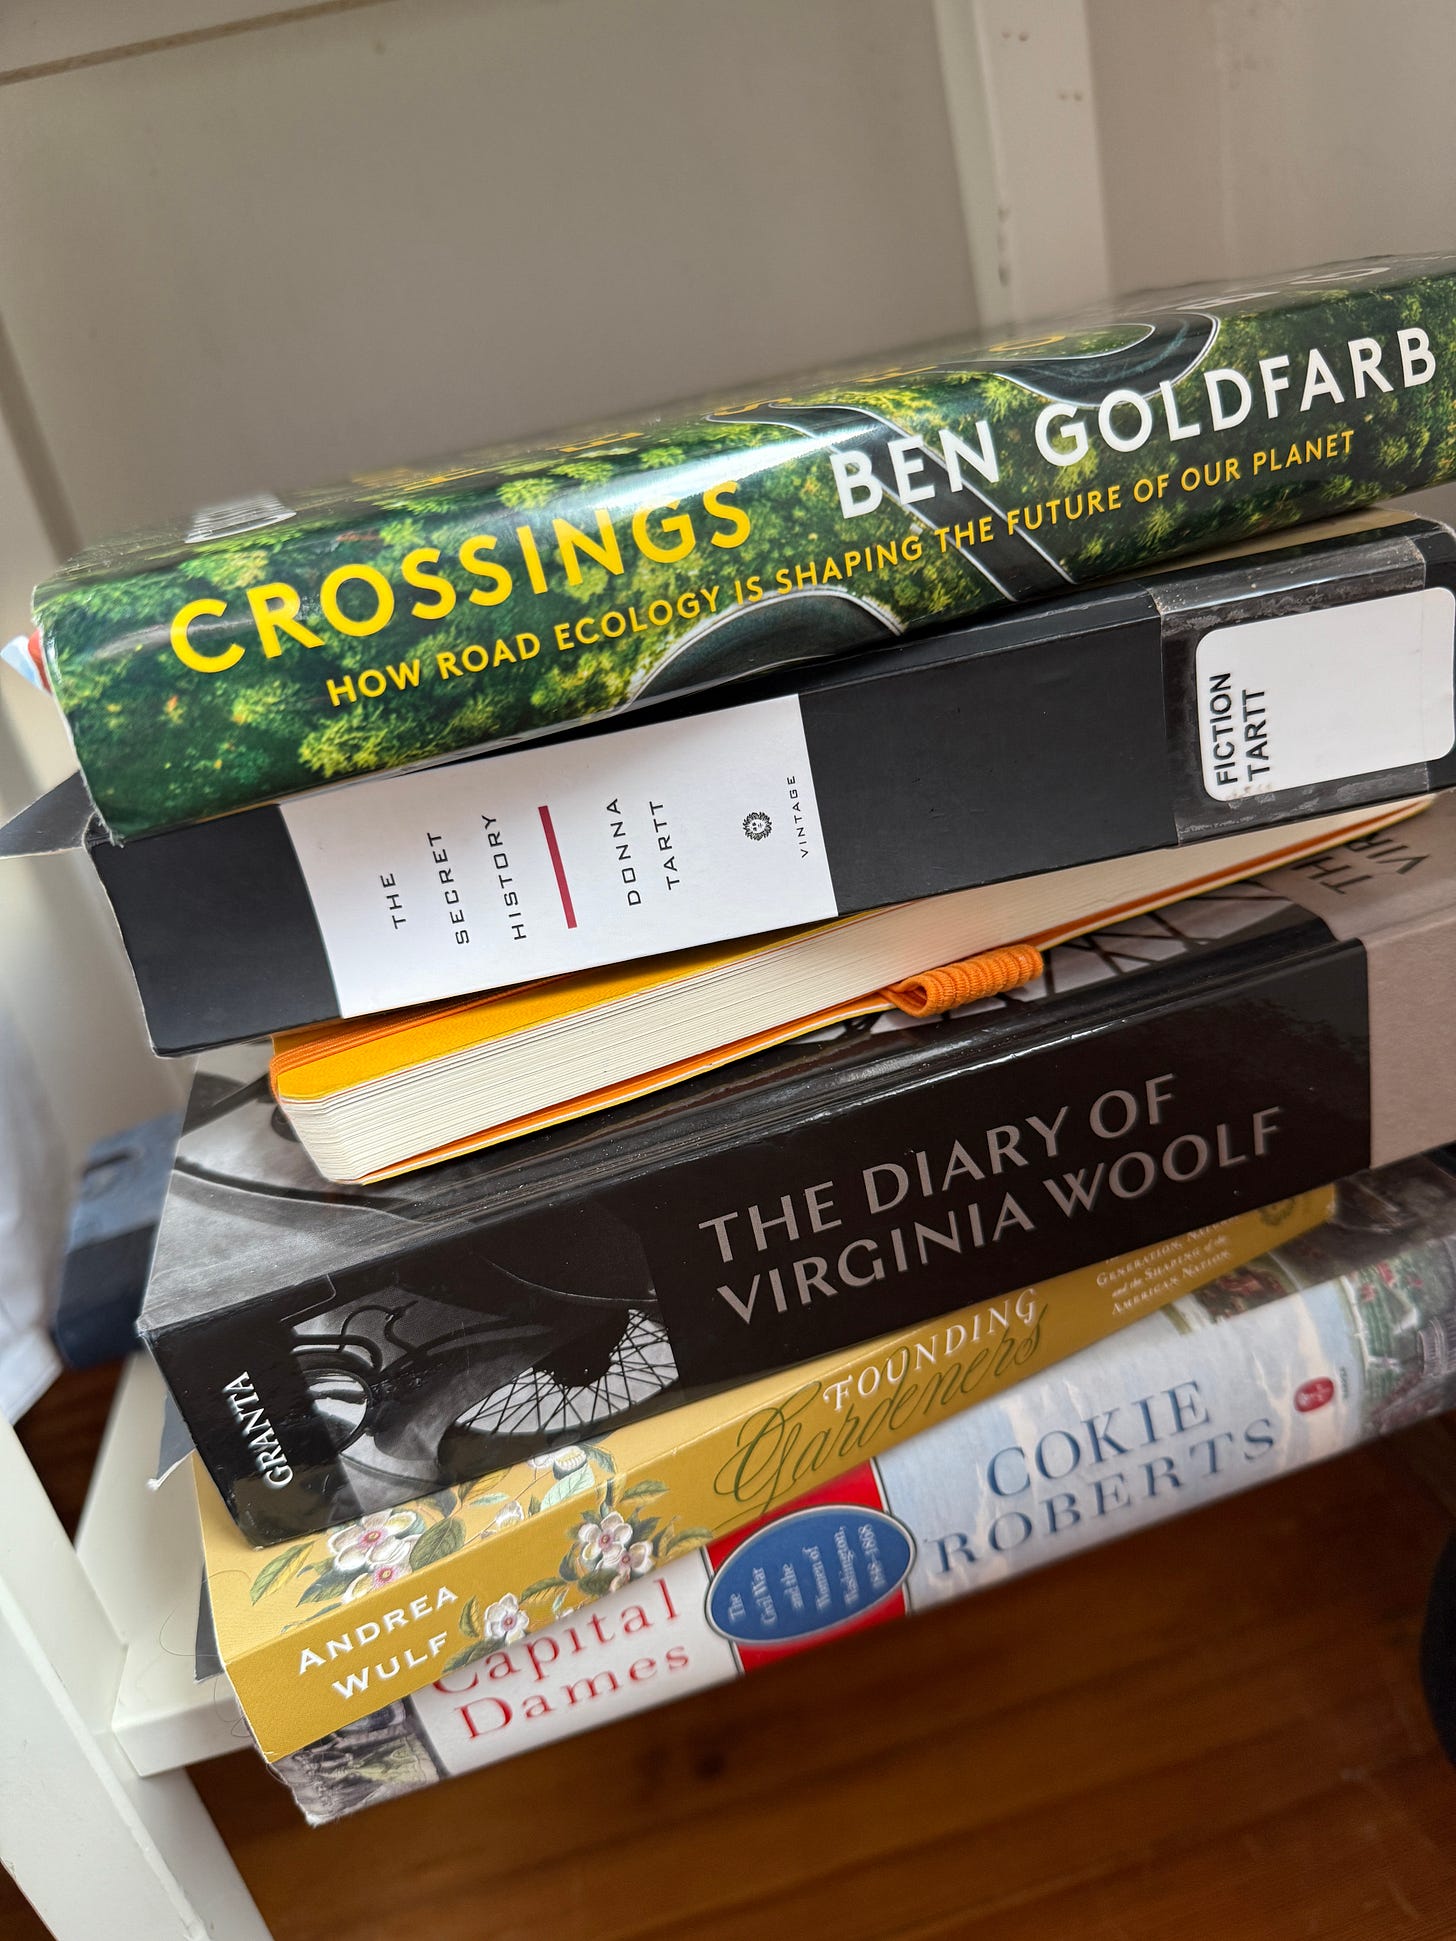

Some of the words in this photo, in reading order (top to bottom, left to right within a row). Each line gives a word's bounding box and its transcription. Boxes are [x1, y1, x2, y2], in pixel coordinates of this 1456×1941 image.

[829, 419, 999, 519] BEN
[1035, 327, 1437, 468] GOLDFARB
[170, 480, 752, 674] CROSSINGS
[326, 659, 421, 707] HOW
[436, 633, 540, 680] ROAD
[554, 589, 719, 651] ECOLOGY
[735, 576, 763, 605] IS
[775, 535, 923, 596] SHAPING
[934, 512, 994, 553] THE
[1007, 483, 1122, 535] FUTURE
[1133, 474, 1170, 503] OF
[1181, 457, 1241, 492] OUR
[1252, 430, 1355, 475] PLANET
[1209, 672, 1238, 786] FICTION
[1242, 689, 1270, 781] TARTT
[606, 797, 641, 906] DONNA
[649, 800, 680, 890] TARTT
[786, 775, 809, 858] VINTAGE
[380, 872, 407, 930] THE
[428, 832, 470, 945] SECRET
[481, 814, 527, 940] HISTORY
[1290, 856, 1372, 895] TH
[699, 1180, 843, 1263] THE
[863, 1106, 1069, 1216] DIARY
[1088, 1073, 1176, 1139] OF
[716, 1196, 1036, 1325] VIRGINIA
[1042, 1106, 1282, 1220] WOOLF
[823, 1288, 1038, 1412] FOUNDING
[221, 1371, 294, 1490] GRANTA
[713, 1303, 1049, 1516] Gardeners
[986, 1380, 1211, 1497] COKIE
[930, 1418, 1275, 1575] ROBERTS
[299, 1585, 459, 1676] ANDREA
[331, 1631, 449, 1700] WULF
[454, 1645, 690, 1739] Dames
